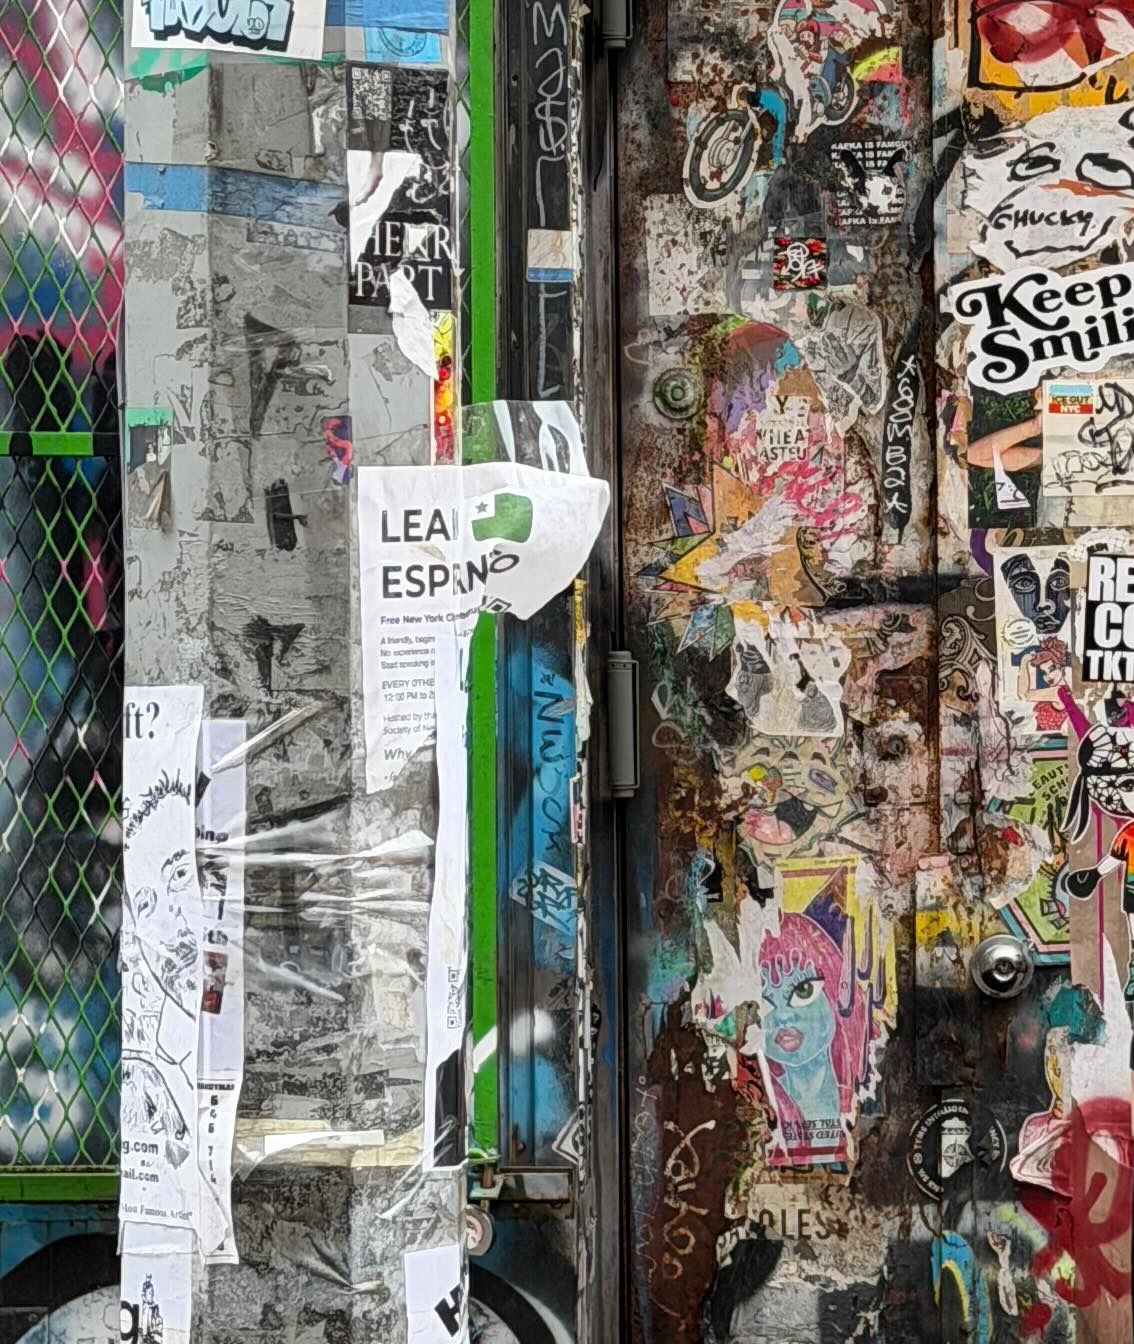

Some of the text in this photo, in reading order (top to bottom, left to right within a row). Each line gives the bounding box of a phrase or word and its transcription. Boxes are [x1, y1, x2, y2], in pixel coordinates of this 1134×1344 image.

[955, 272, 1133, 334] Keep
[1051, 395, 1090, 404] ICE OUT
[1060, 404, 1081, 414] NYC
[381, 508, 459, 543] LEA
[381, 615, 401, 625] Free
[403, 614, 422, 624] New
[424, 613, 444, 624] York
[382, 679, 410, 690] EVERY
